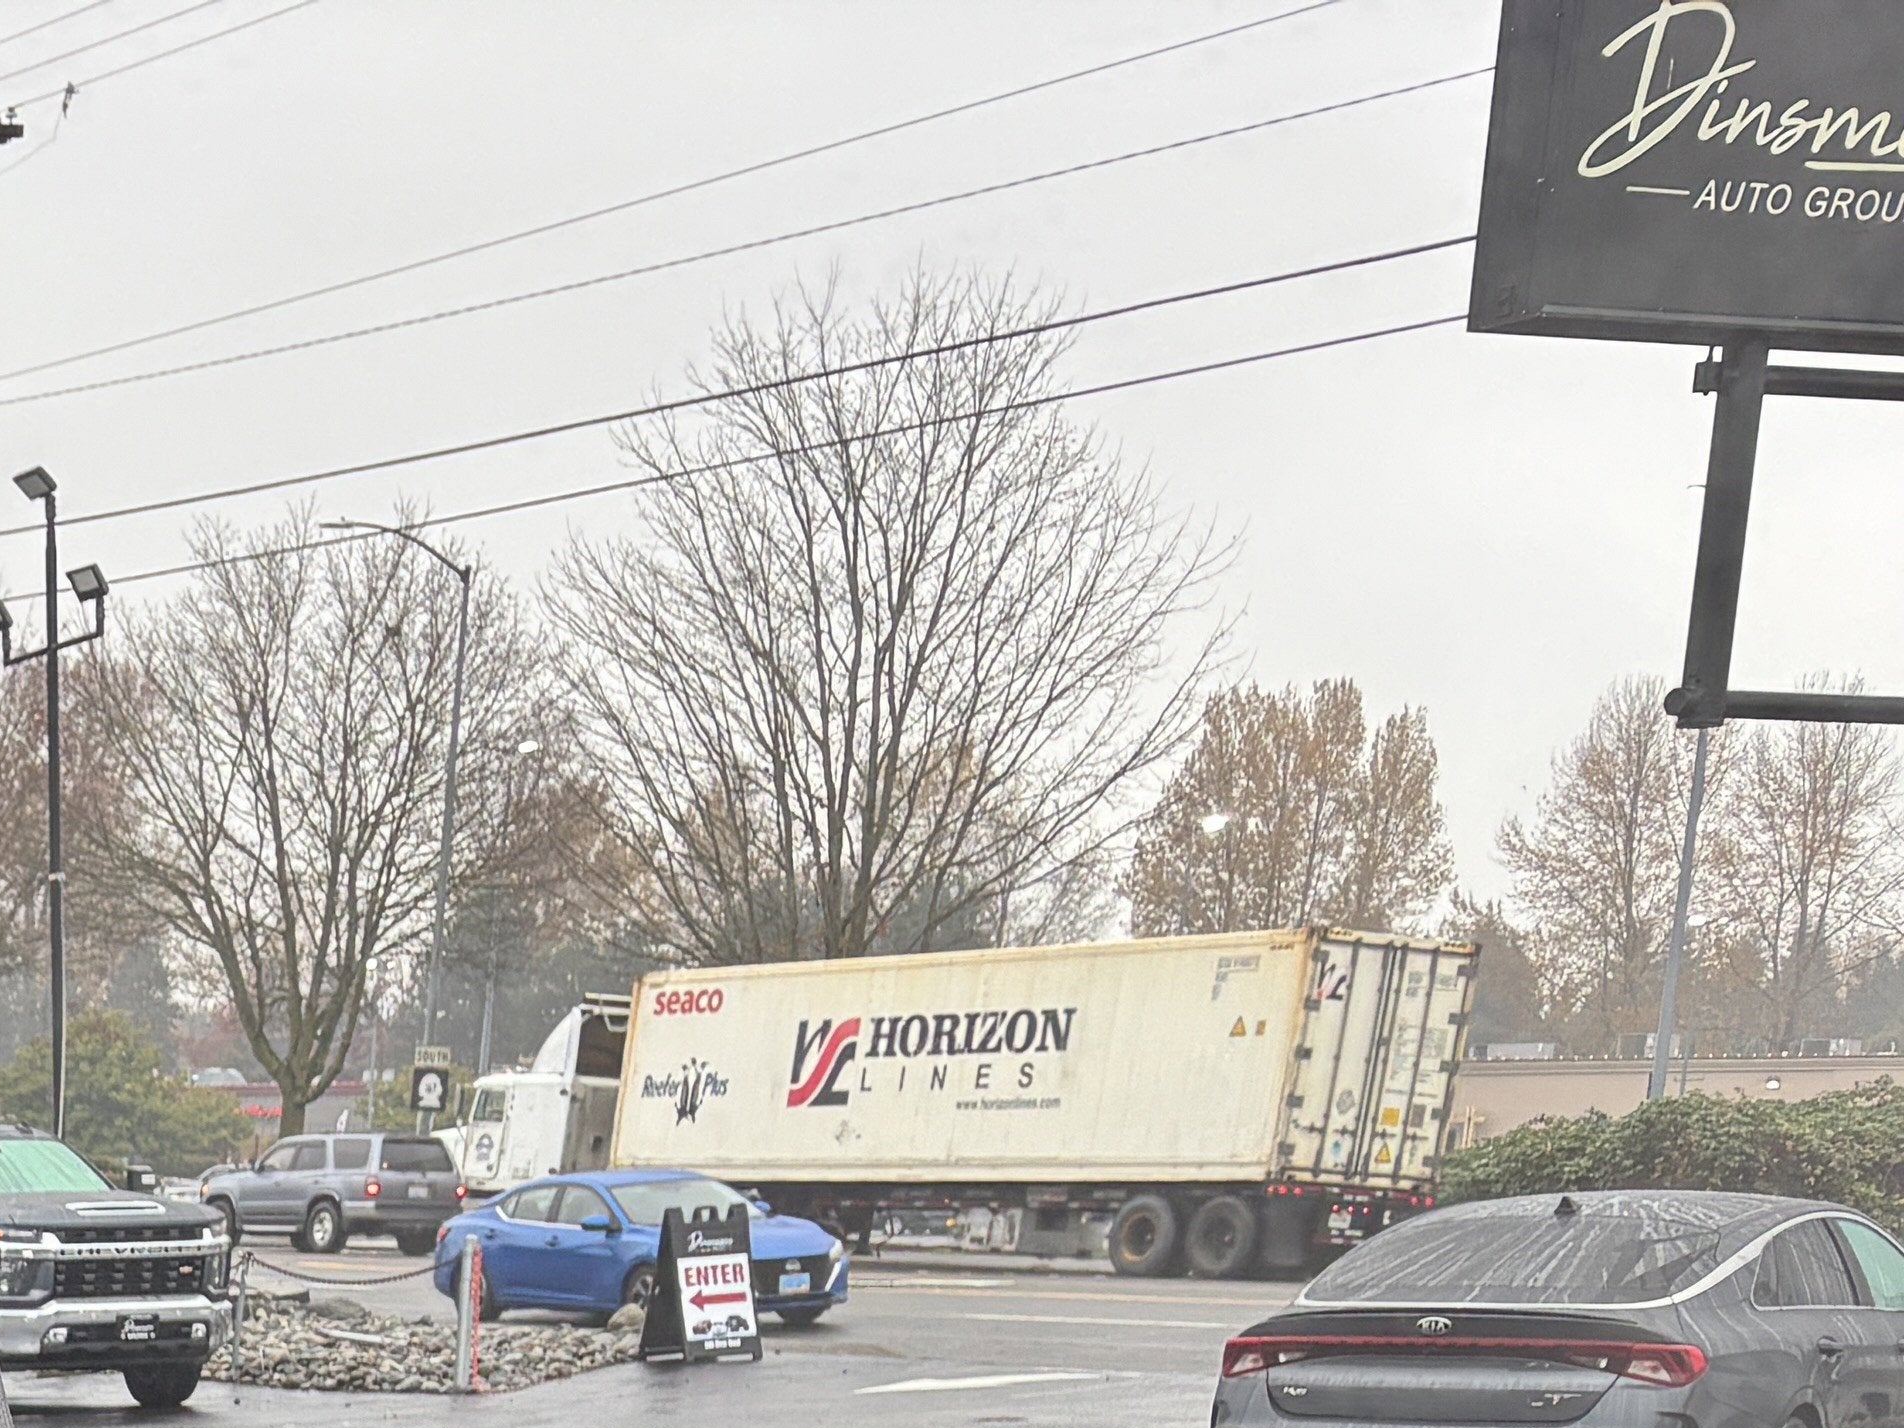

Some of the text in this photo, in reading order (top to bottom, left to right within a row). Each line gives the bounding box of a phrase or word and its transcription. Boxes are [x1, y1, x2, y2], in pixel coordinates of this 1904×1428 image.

[1577, 0, 1904, 177] Dinsm
[1693, 178, 1904, 223] AUTO GROU
[653, 987, 724, 1017] seaco
[864, 1007, 1078, 1058] HORIZON
[417, 1049, 449, 1063] SOUTH
[860, 1062, 1035, 1092] LINES
[683, 1263, 745, 1287] ENTER
